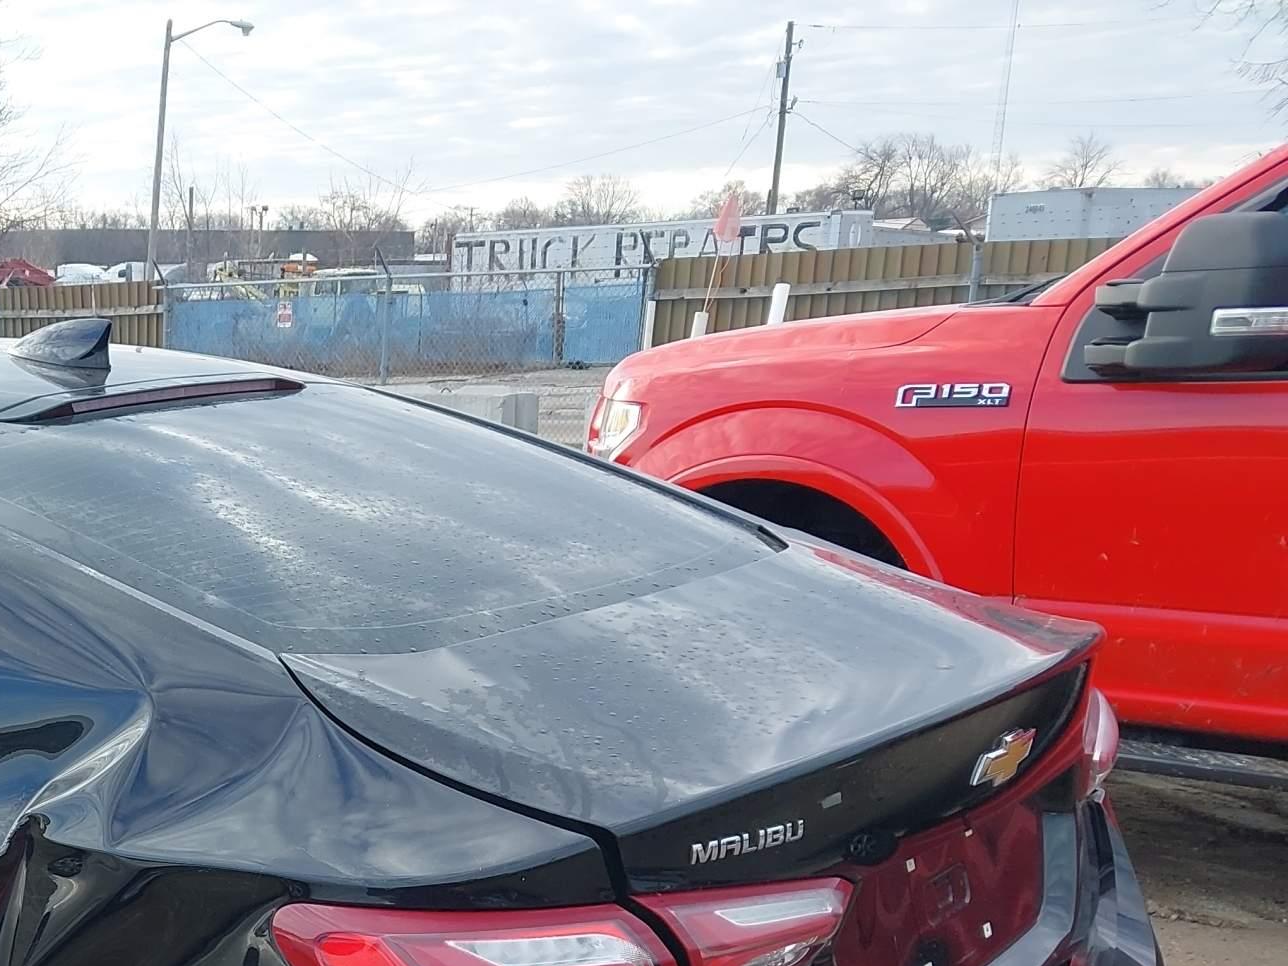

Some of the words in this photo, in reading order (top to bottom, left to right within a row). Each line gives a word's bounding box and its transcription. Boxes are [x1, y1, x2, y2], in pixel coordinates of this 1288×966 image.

[455, 233, 596, 281] TRUCK
[977, 398, 1004, 406] XLT
[691, 820, 805, 865] MALIBU
